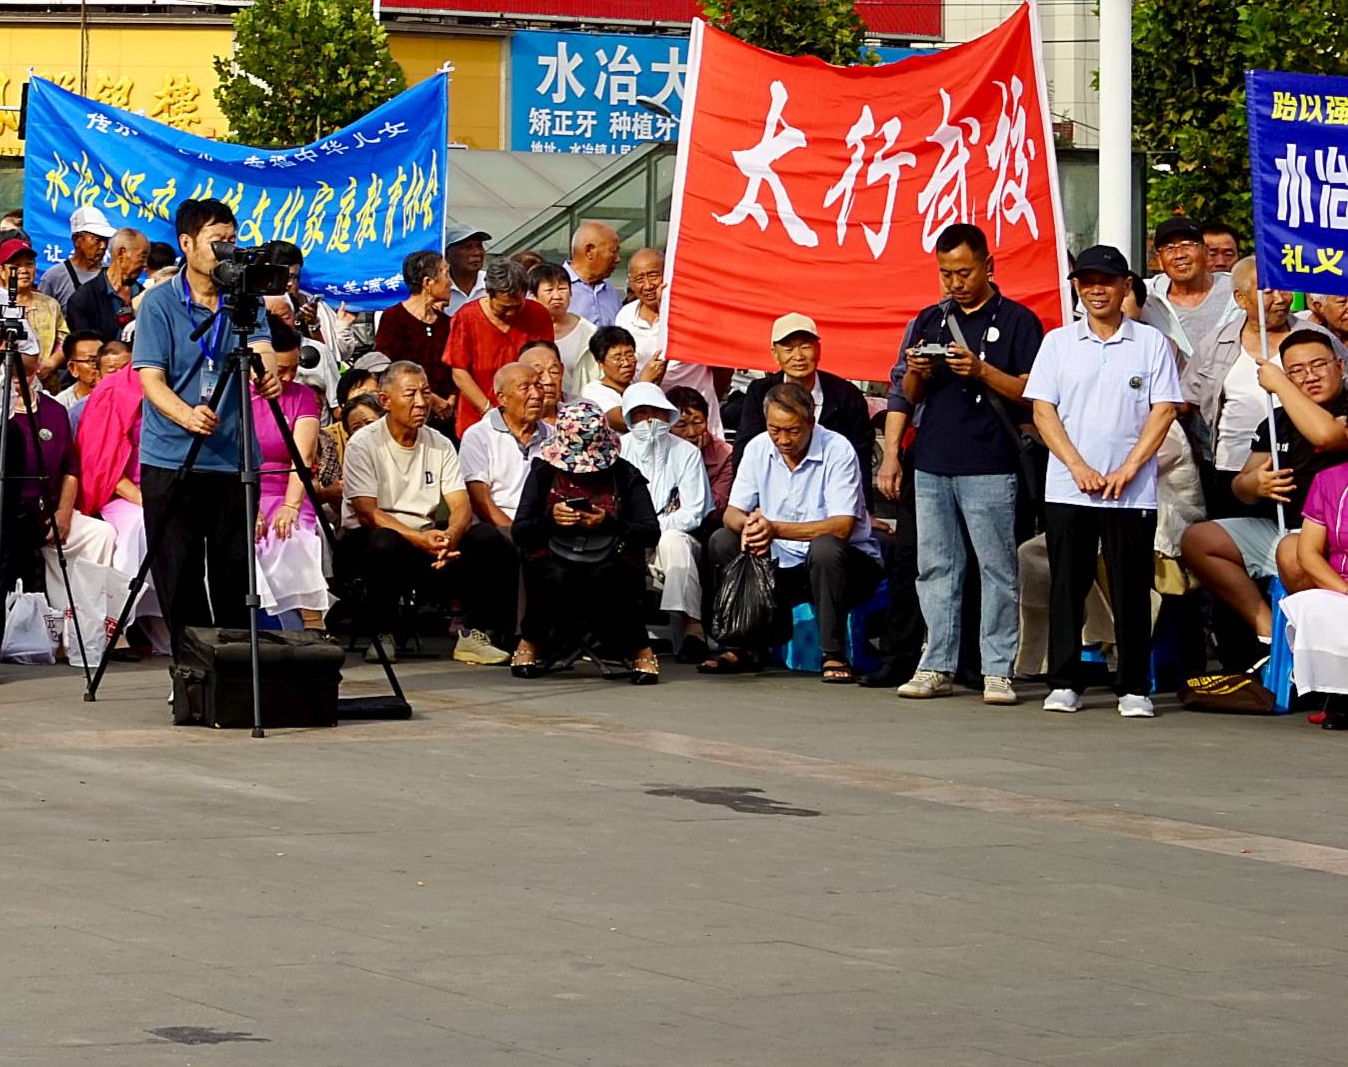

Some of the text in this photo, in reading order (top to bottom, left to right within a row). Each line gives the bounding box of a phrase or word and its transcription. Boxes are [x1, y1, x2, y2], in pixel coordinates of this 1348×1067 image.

[536, 41, 688, 106] 水冶大
[528, 107, 677, 141] 矫正牙 种植牙
[1271, 91, 1348, 125] 跆以强
[712, 78, 1039, 260] 太行武校
[1275, 143, 1348, 230] 水冶
[1281, 244, 1343, 276] 礼义
